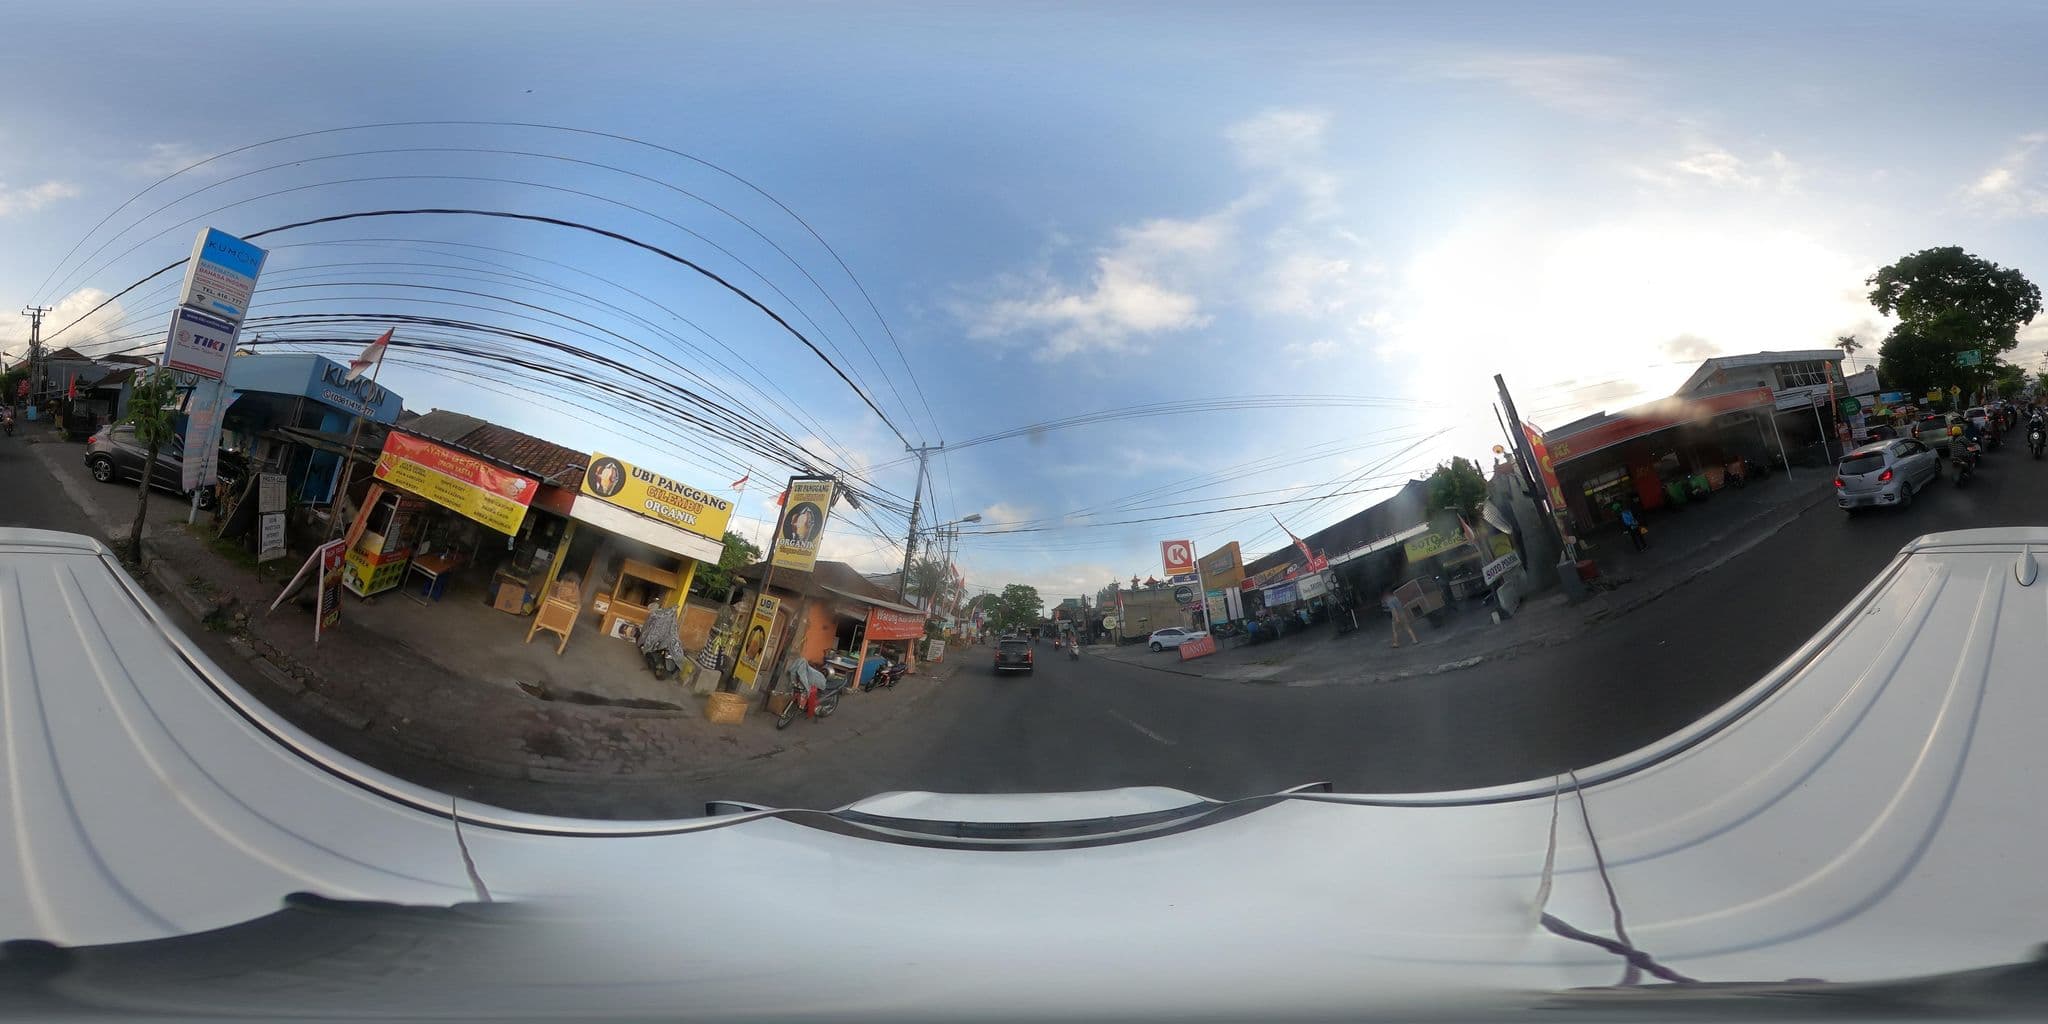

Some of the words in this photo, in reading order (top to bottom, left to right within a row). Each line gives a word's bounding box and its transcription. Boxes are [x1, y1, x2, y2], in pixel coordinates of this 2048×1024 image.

[208, 240, 258, 266] KUMON
[199, 267, 225, 281] BAHASA
[193, 334, 226, 352] TIKI
[322, 363, 387, 407] KUMON
[632, 466, 655, 486] UBI
[658, 476, 727, 511] PANGGANG
[646, 485, 704, 515] CILEMBU
[644, 499, 697, 526] ORGANIK
[780, 538, 816, 550] ORGANIK
[1486, 564, 1502, 580] SOTO
[760, 598, 775, 610] UBI
